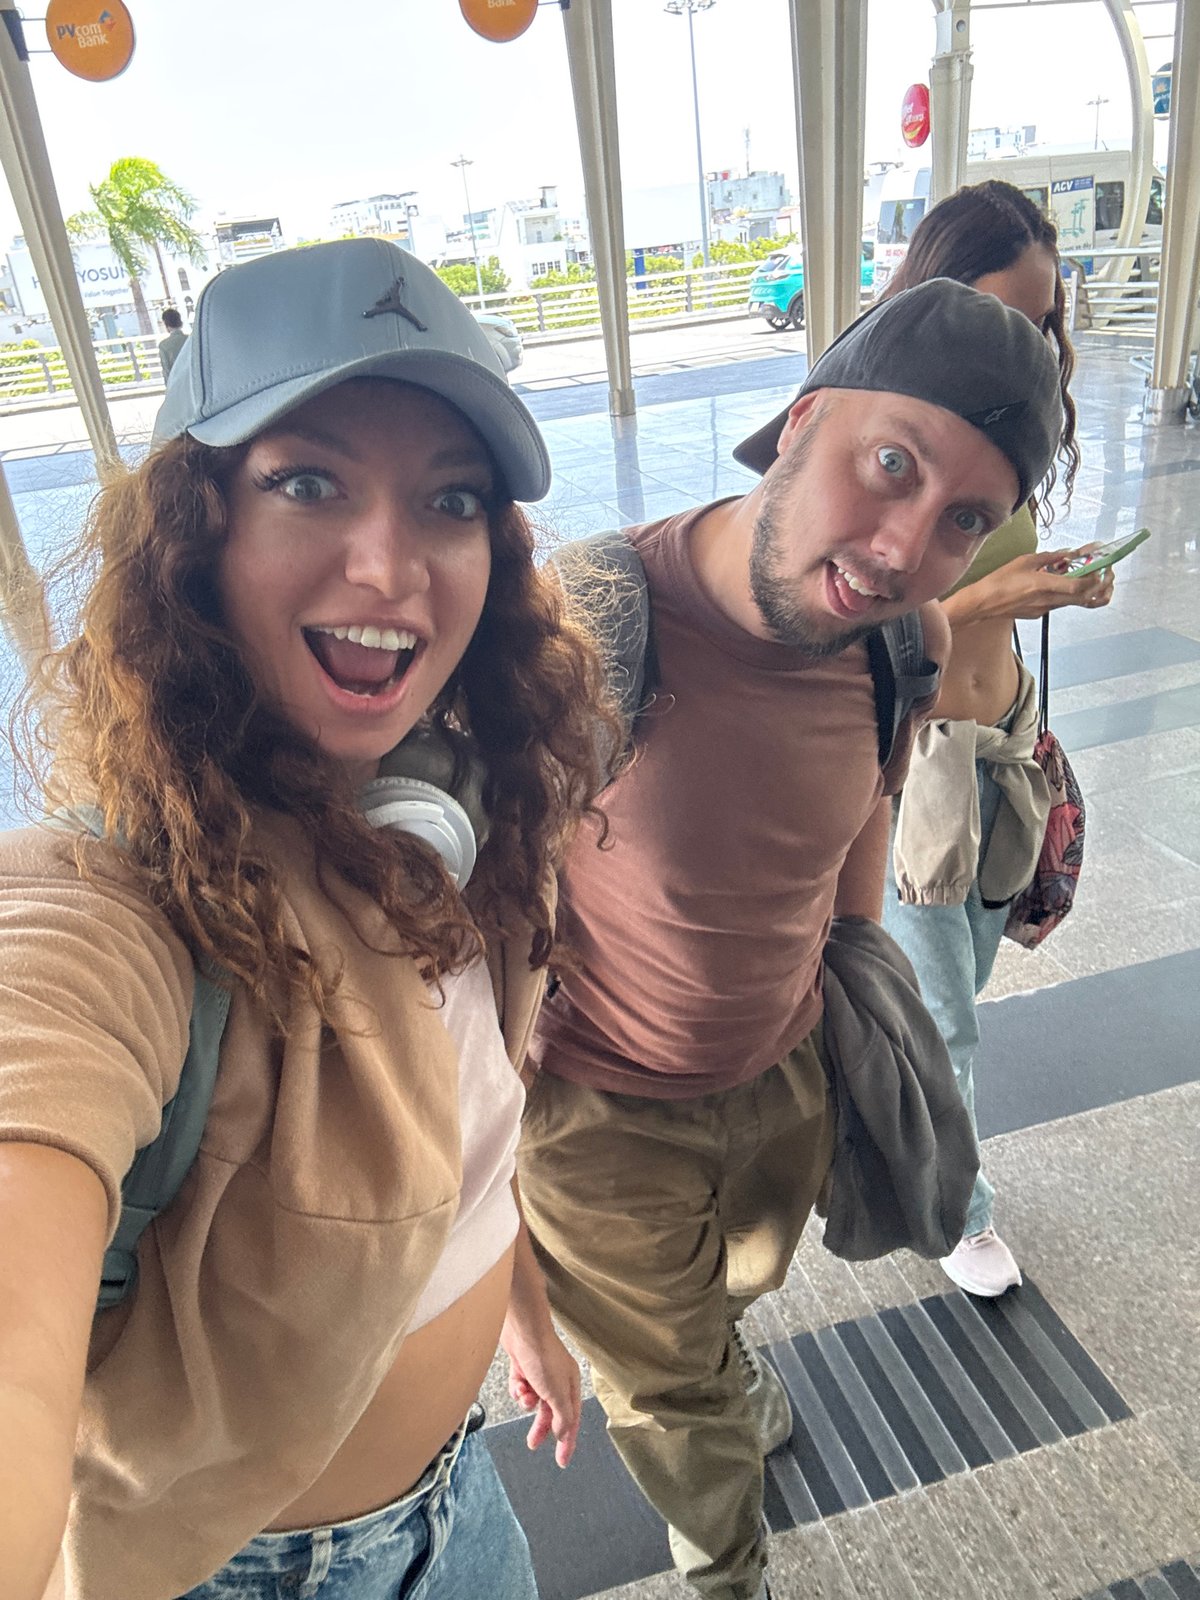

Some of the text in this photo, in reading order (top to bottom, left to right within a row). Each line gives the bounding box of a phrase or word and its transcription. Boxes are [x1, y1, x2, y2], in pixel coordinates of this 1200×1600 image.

[77, 33, 109, 48] Bank
[1053, 180, 1073, 193] ACV
[101, 287, 129, 297] Together
